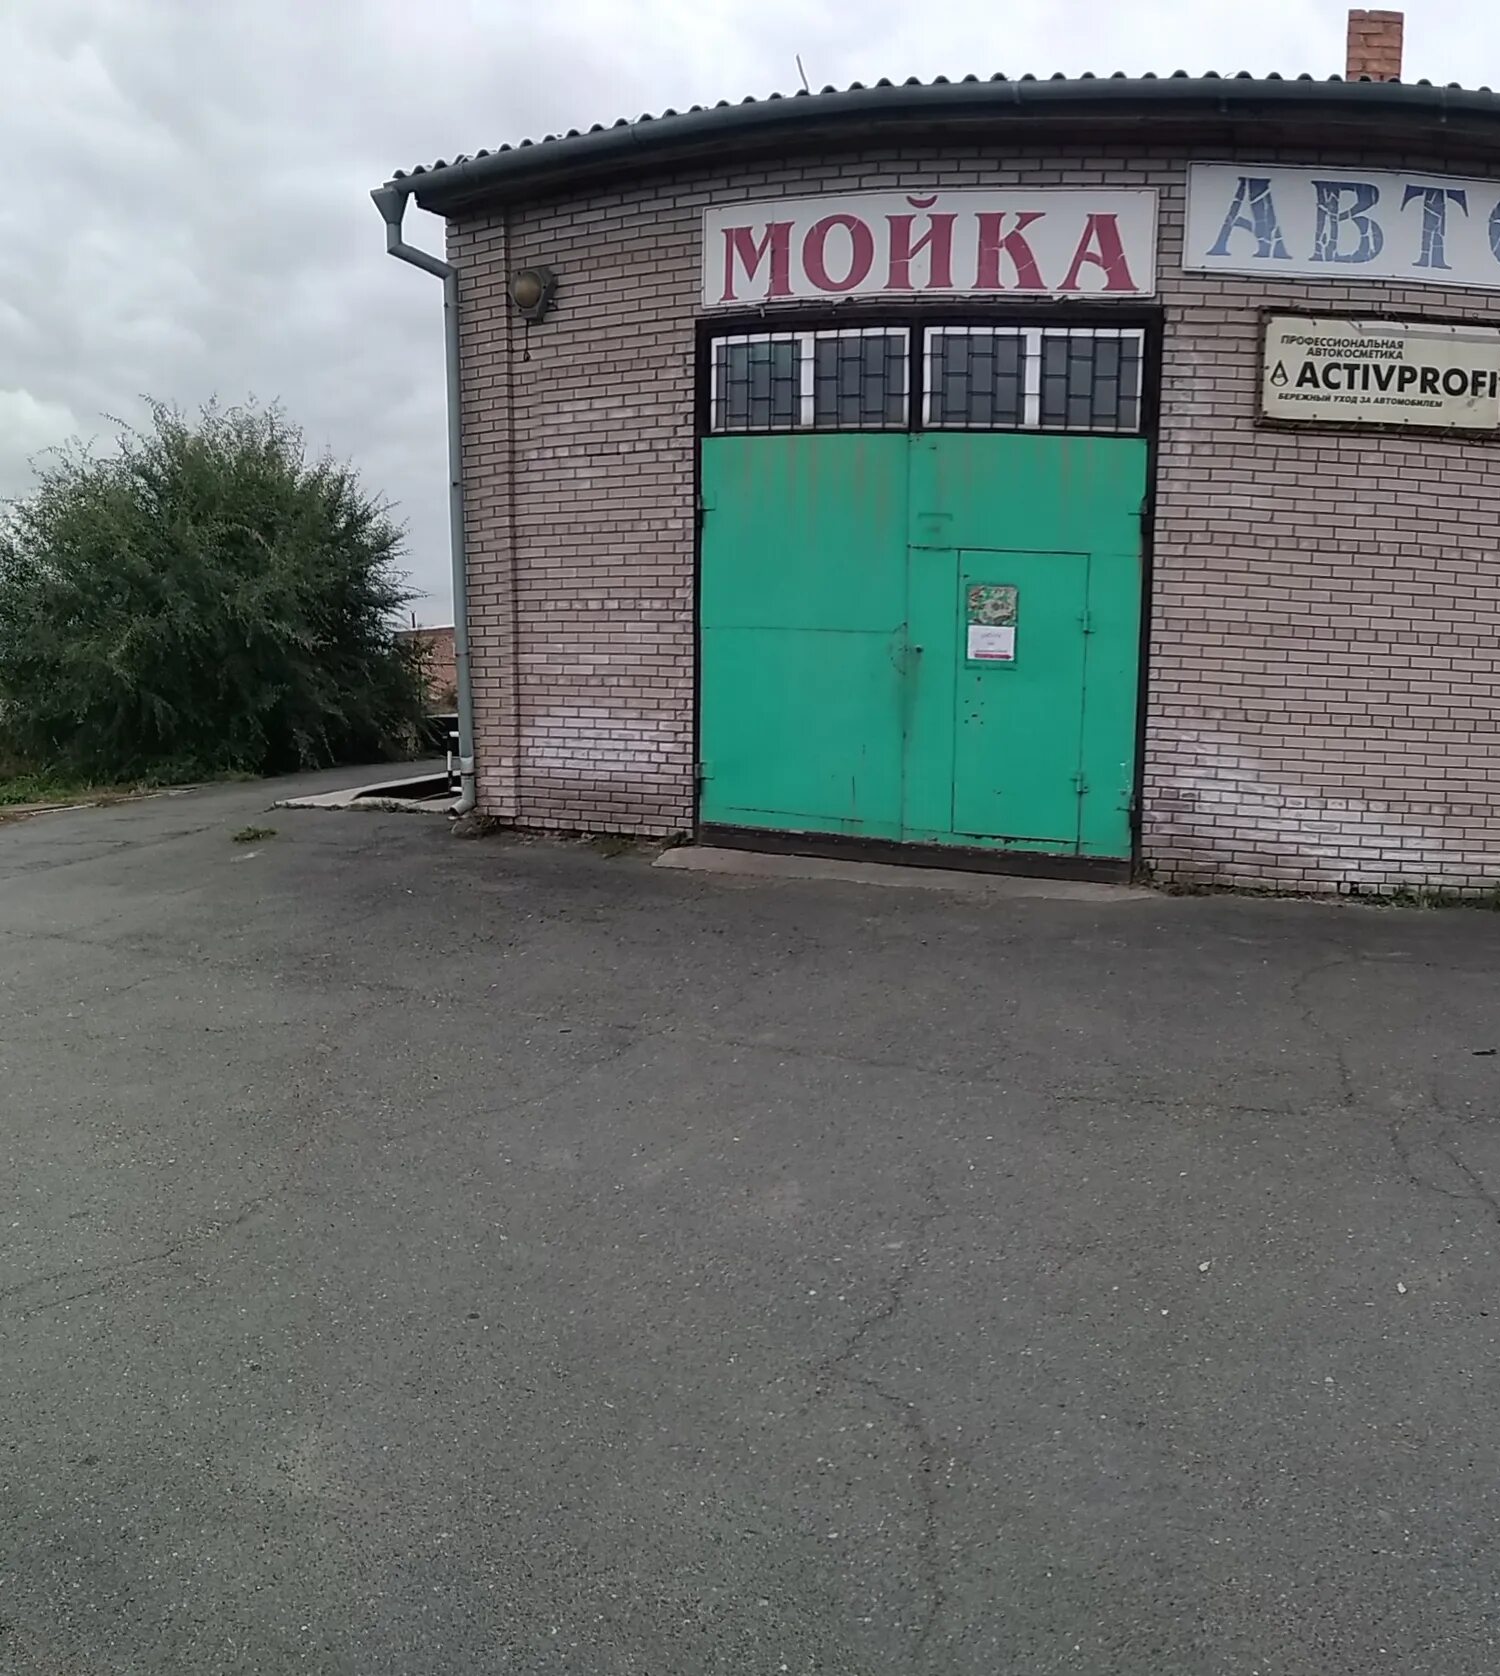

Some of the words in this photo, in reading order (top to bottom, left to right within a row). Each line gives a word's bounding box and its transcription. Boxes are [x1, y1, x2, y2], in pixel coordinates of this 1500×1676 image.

[719, 194, 1140, 301] МОЙКА
[1280, 335, 1404, 350] ПРОФЕССИОНАЛЬНАЯ
[1306, 347, 1403, 360] АВТОКОСМЕТИКА
[1295, 361, 1498, 398] ACTIVPROFI
[1277, 392, 1331, 402] БЕРЕЖНЫЙ
[1333, 395, 1358, 404] УХОД
[1359, 396, 1372, 404] ЗА
[1373, 398, 1443, 408] АВТОМОБИЛЕМ
